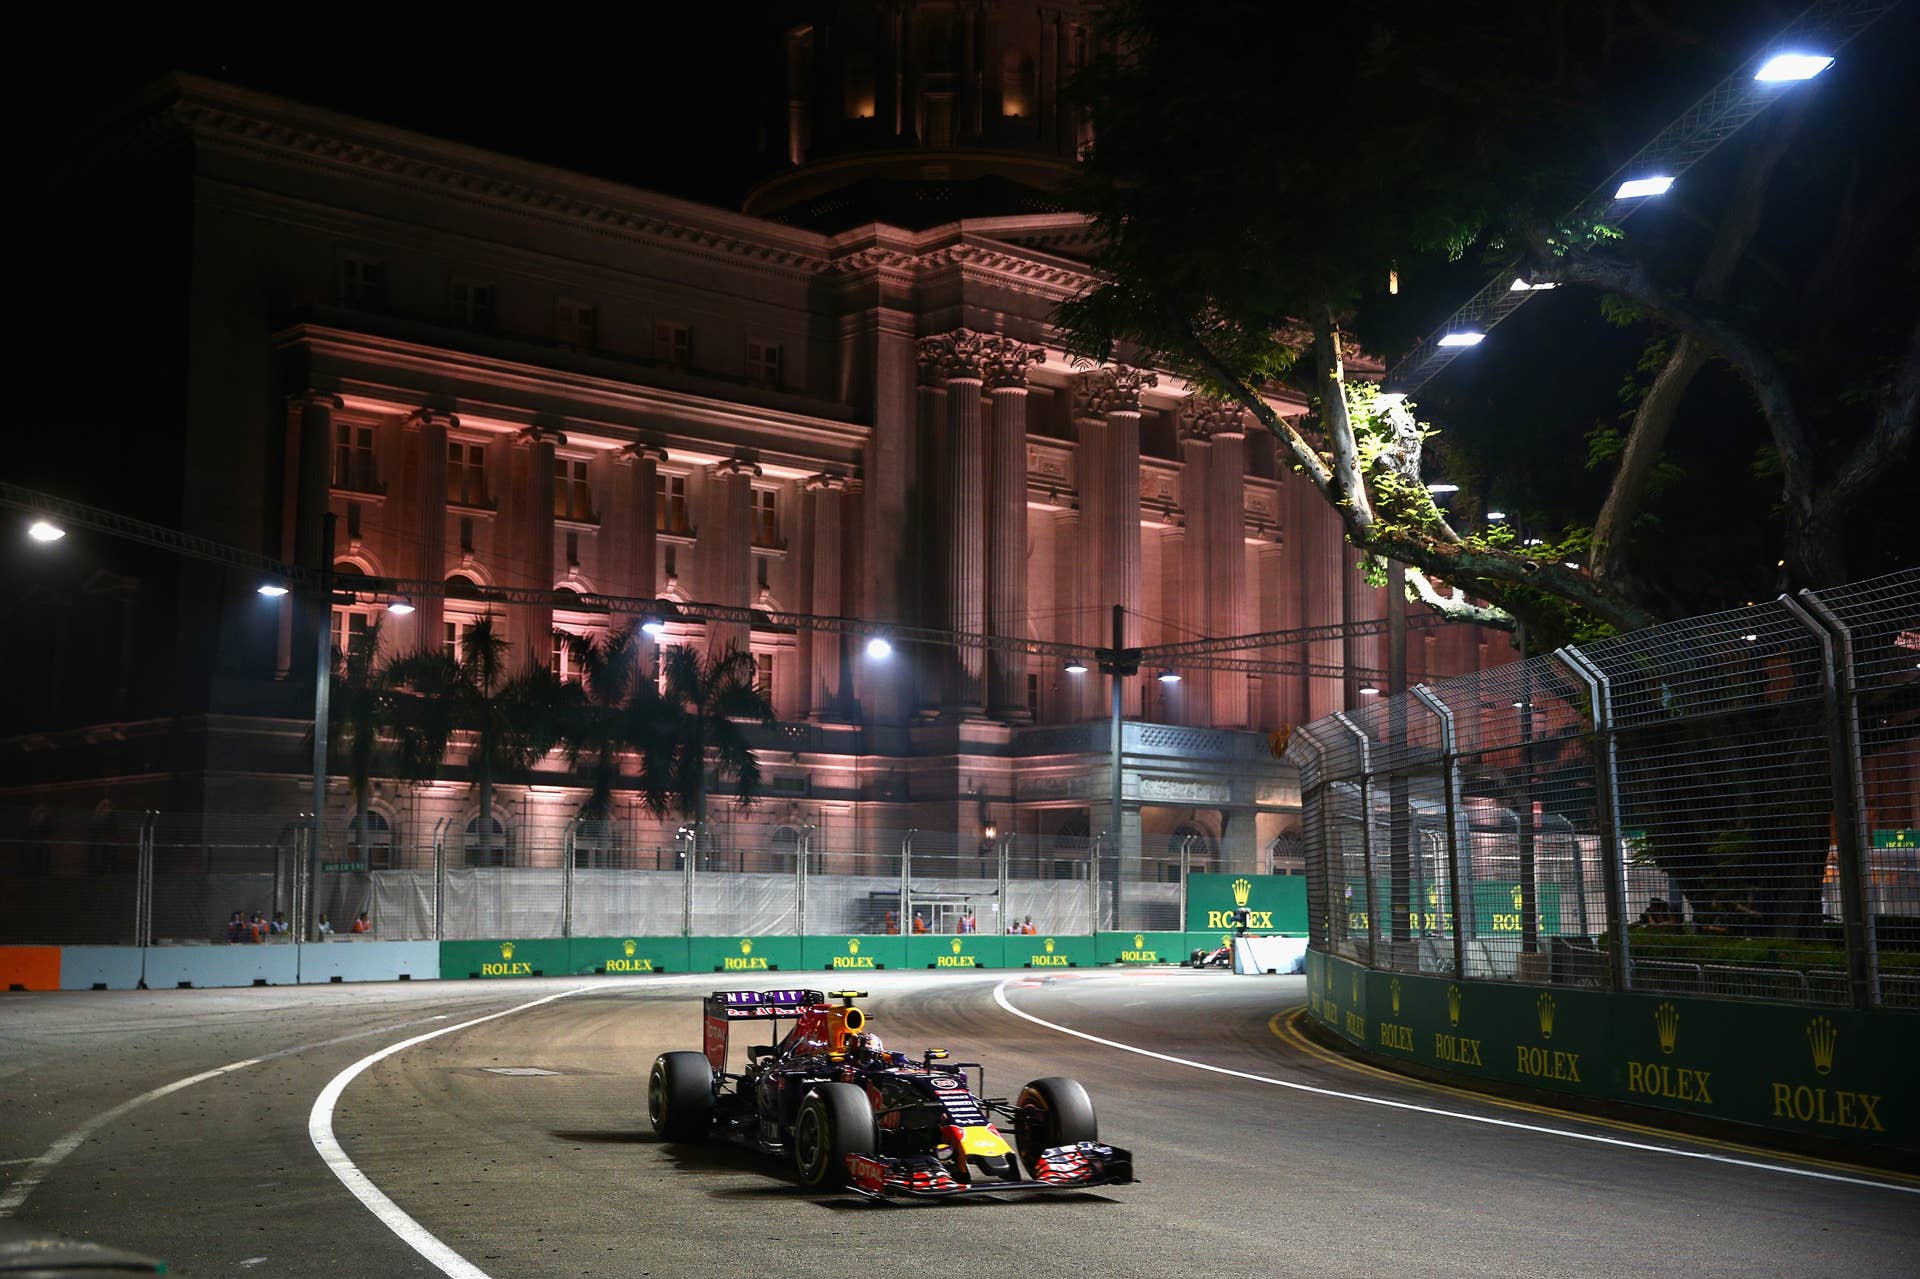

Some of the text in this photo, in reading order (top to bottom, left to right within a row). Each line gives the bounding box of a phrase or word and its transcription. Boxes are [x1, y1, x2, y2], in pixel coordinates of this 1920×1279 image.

[1208, 911, 1273, 929] ROEX
[833, 956, 874, 968] ROLEX
[937, 956, 975, 967] ROLEX
[1031, 954, 1067, 966] ROLEX
[1121, 950, 1156, 961] ROLEX
[482, 962, 532, 976] ROLEX
[605, 959, 652, 971] ROLEX
[724, 957, 768, 969] ROLEX
[1381, 1023, 1414, 1052] ROLEX
[1435, 1033, 1482, 1066] ROLEX
[1516, 1045, 1581, 1083] ROLEX
[1628, 1061, 1713, 1104] ROLEX
[1772, 1083, 1886, 1132] ROLEX
